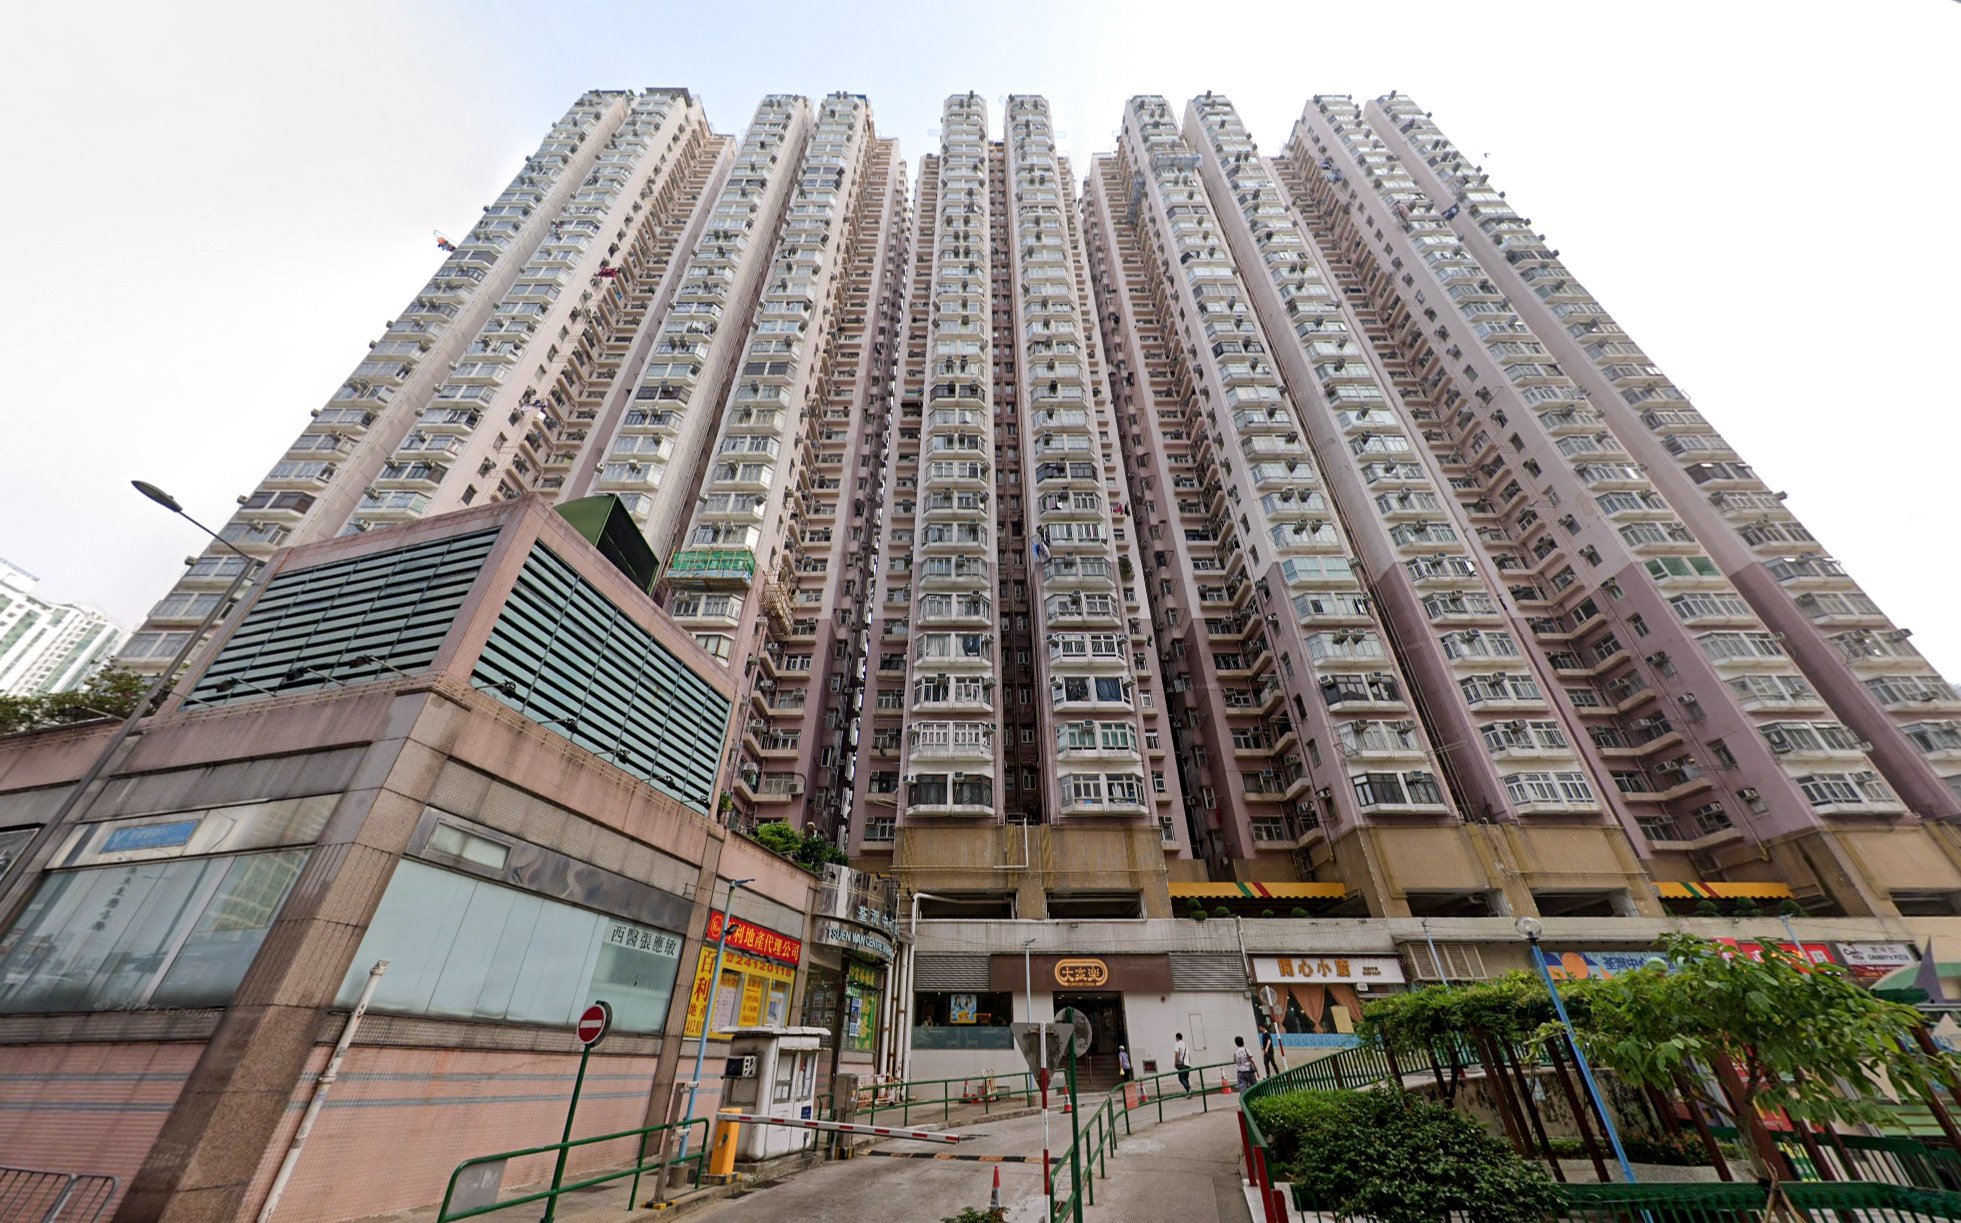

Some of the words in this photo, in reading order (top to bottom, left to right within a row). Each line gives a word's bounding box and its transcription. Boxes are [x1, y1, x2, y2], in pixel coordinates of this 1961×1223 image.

[828, 926, 851, 942] TSUEN
[852, 932, 866, 946] WAN
[694, 950, 717, 1003] 百利
[736, 956, 792, 977] 24120118
